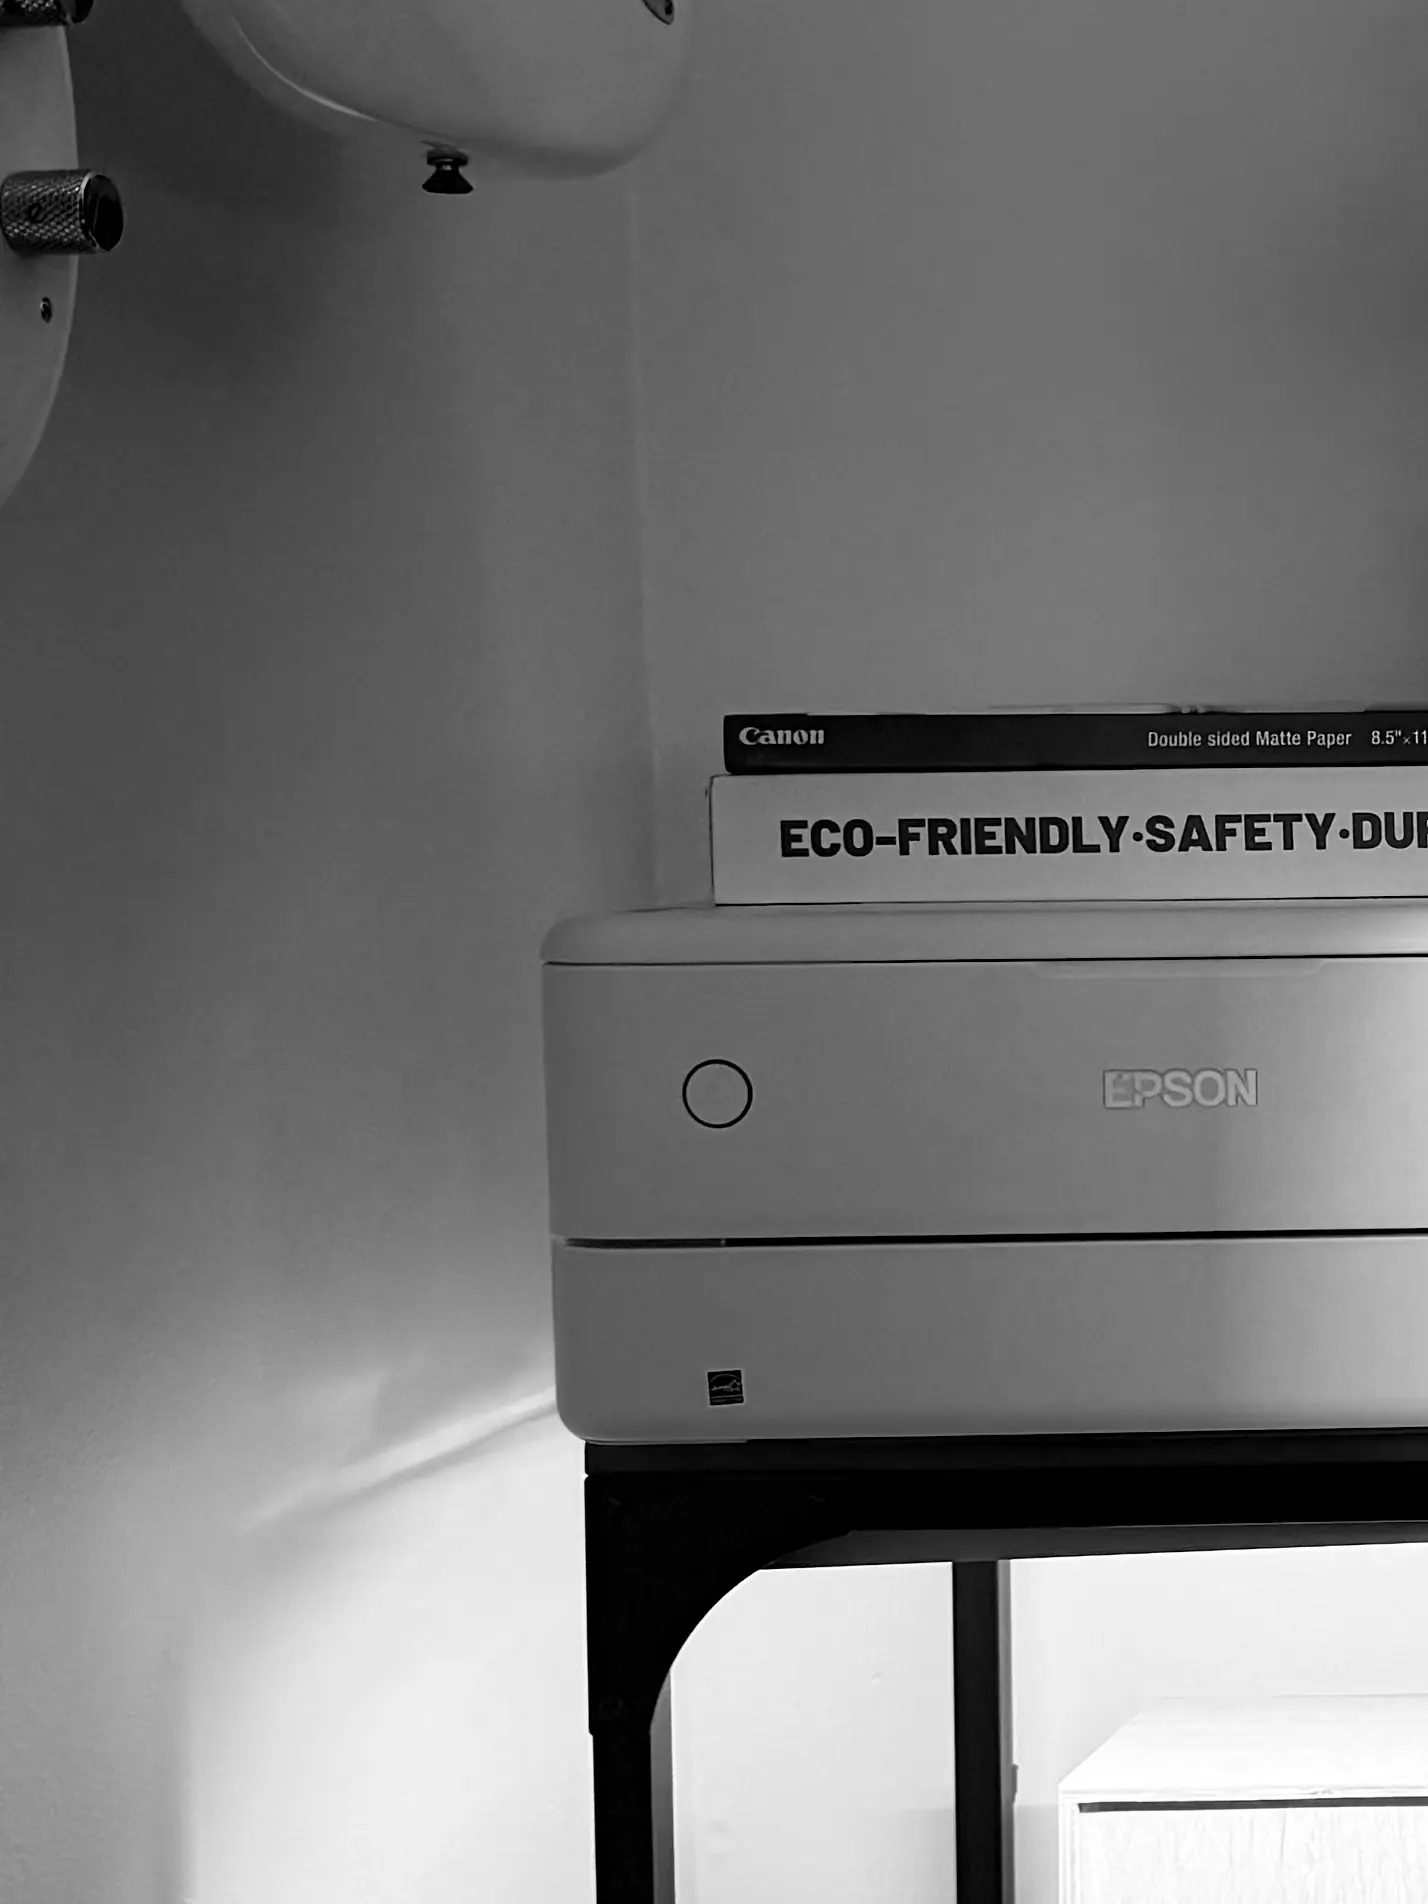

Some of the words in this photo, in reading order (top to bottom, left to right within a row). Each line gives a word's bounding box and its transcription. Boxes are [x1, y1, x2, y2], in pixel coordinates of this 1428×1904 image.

[738, 726, 825, 746] Canon
[1147, 730, 1202, 747] Double
[1207, 729, 1250, 746] sided
[1255, 730, 1301, 746] Matte
[1307, 730, 1352, 750] Paper
[1102, 1068, 1258, 1110] EPSON
